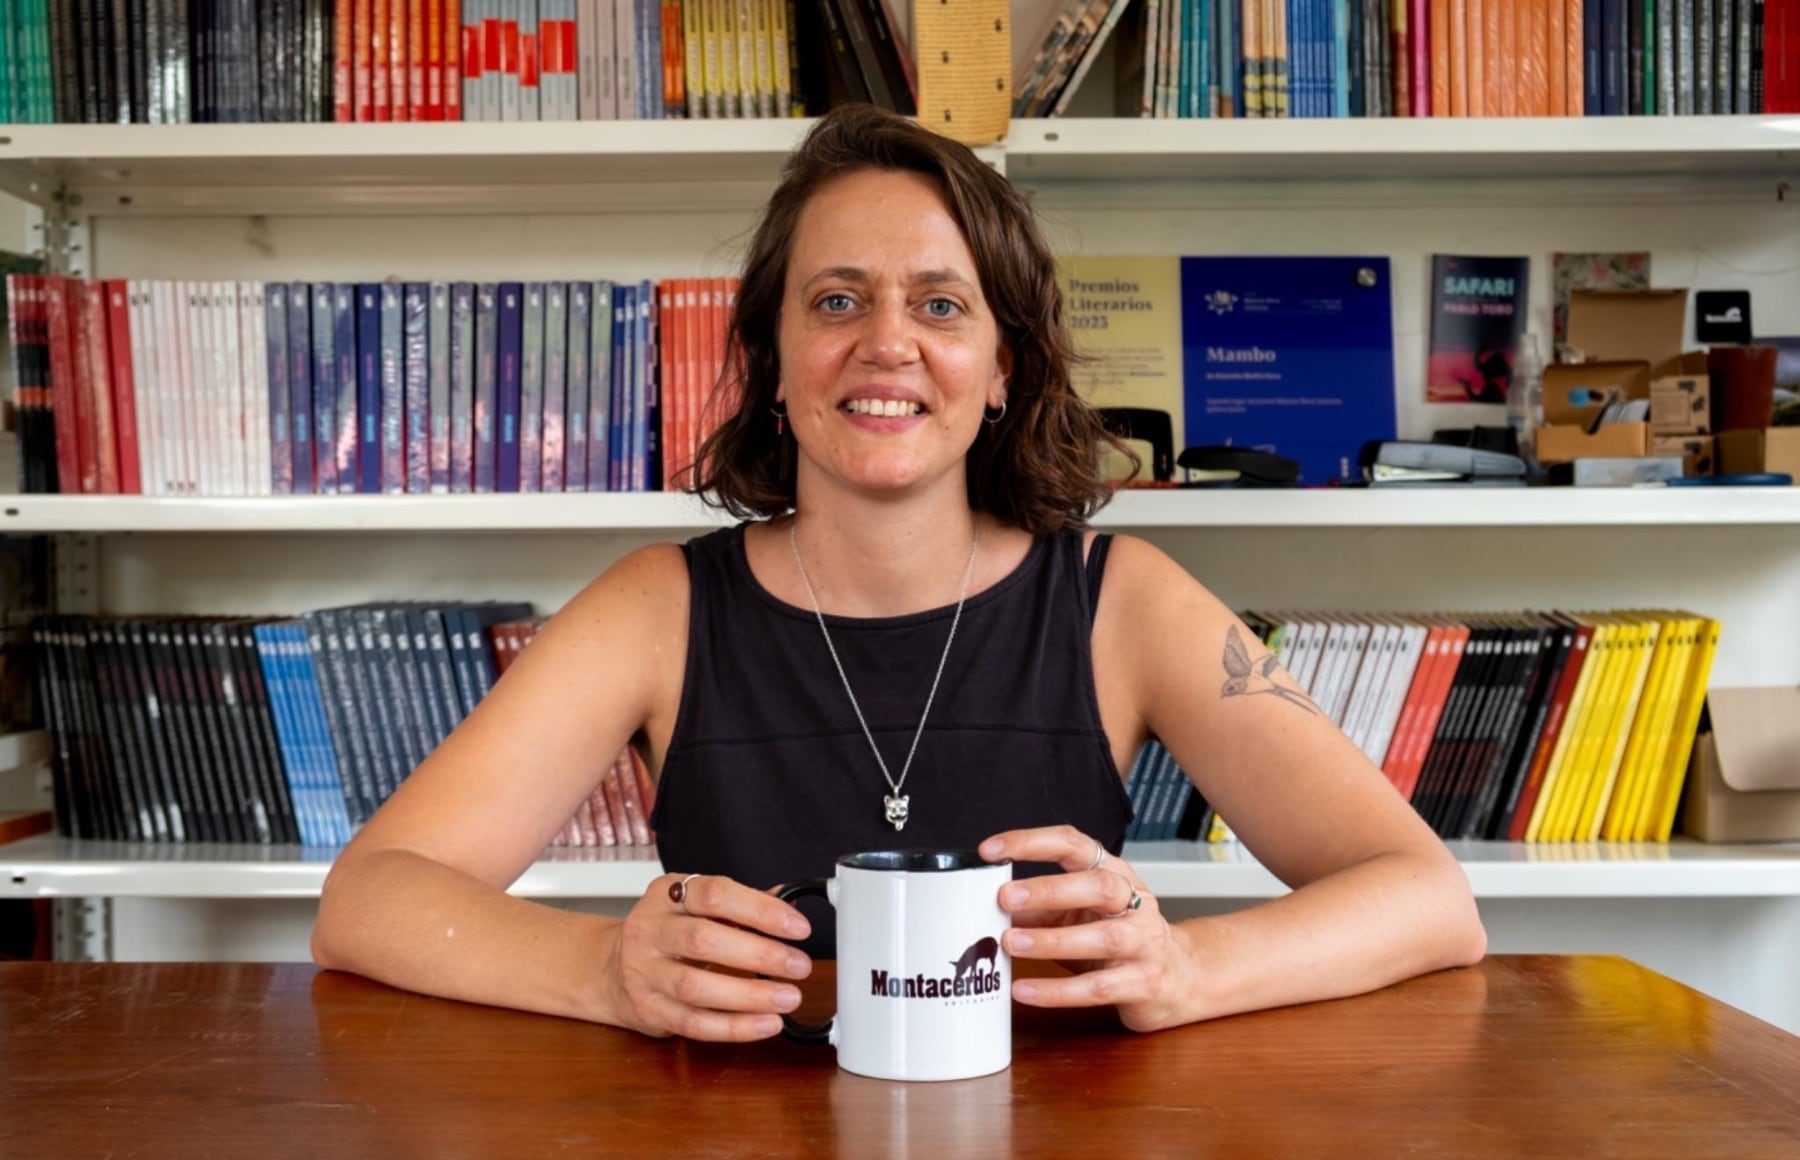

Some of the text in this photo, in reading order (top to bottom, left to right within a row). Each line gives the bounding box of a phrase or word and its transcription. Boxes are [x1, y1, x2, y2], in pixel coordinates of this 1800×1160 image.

[1069, 278, 1139, 293] Premios
[1444, 277, 1515, 296] SAFARI
[1069, 297, 1153, 311] Literarios
[1206, 346, 1277, 362] Mambo
[871, 968, 1001, 998] Montacerdos
